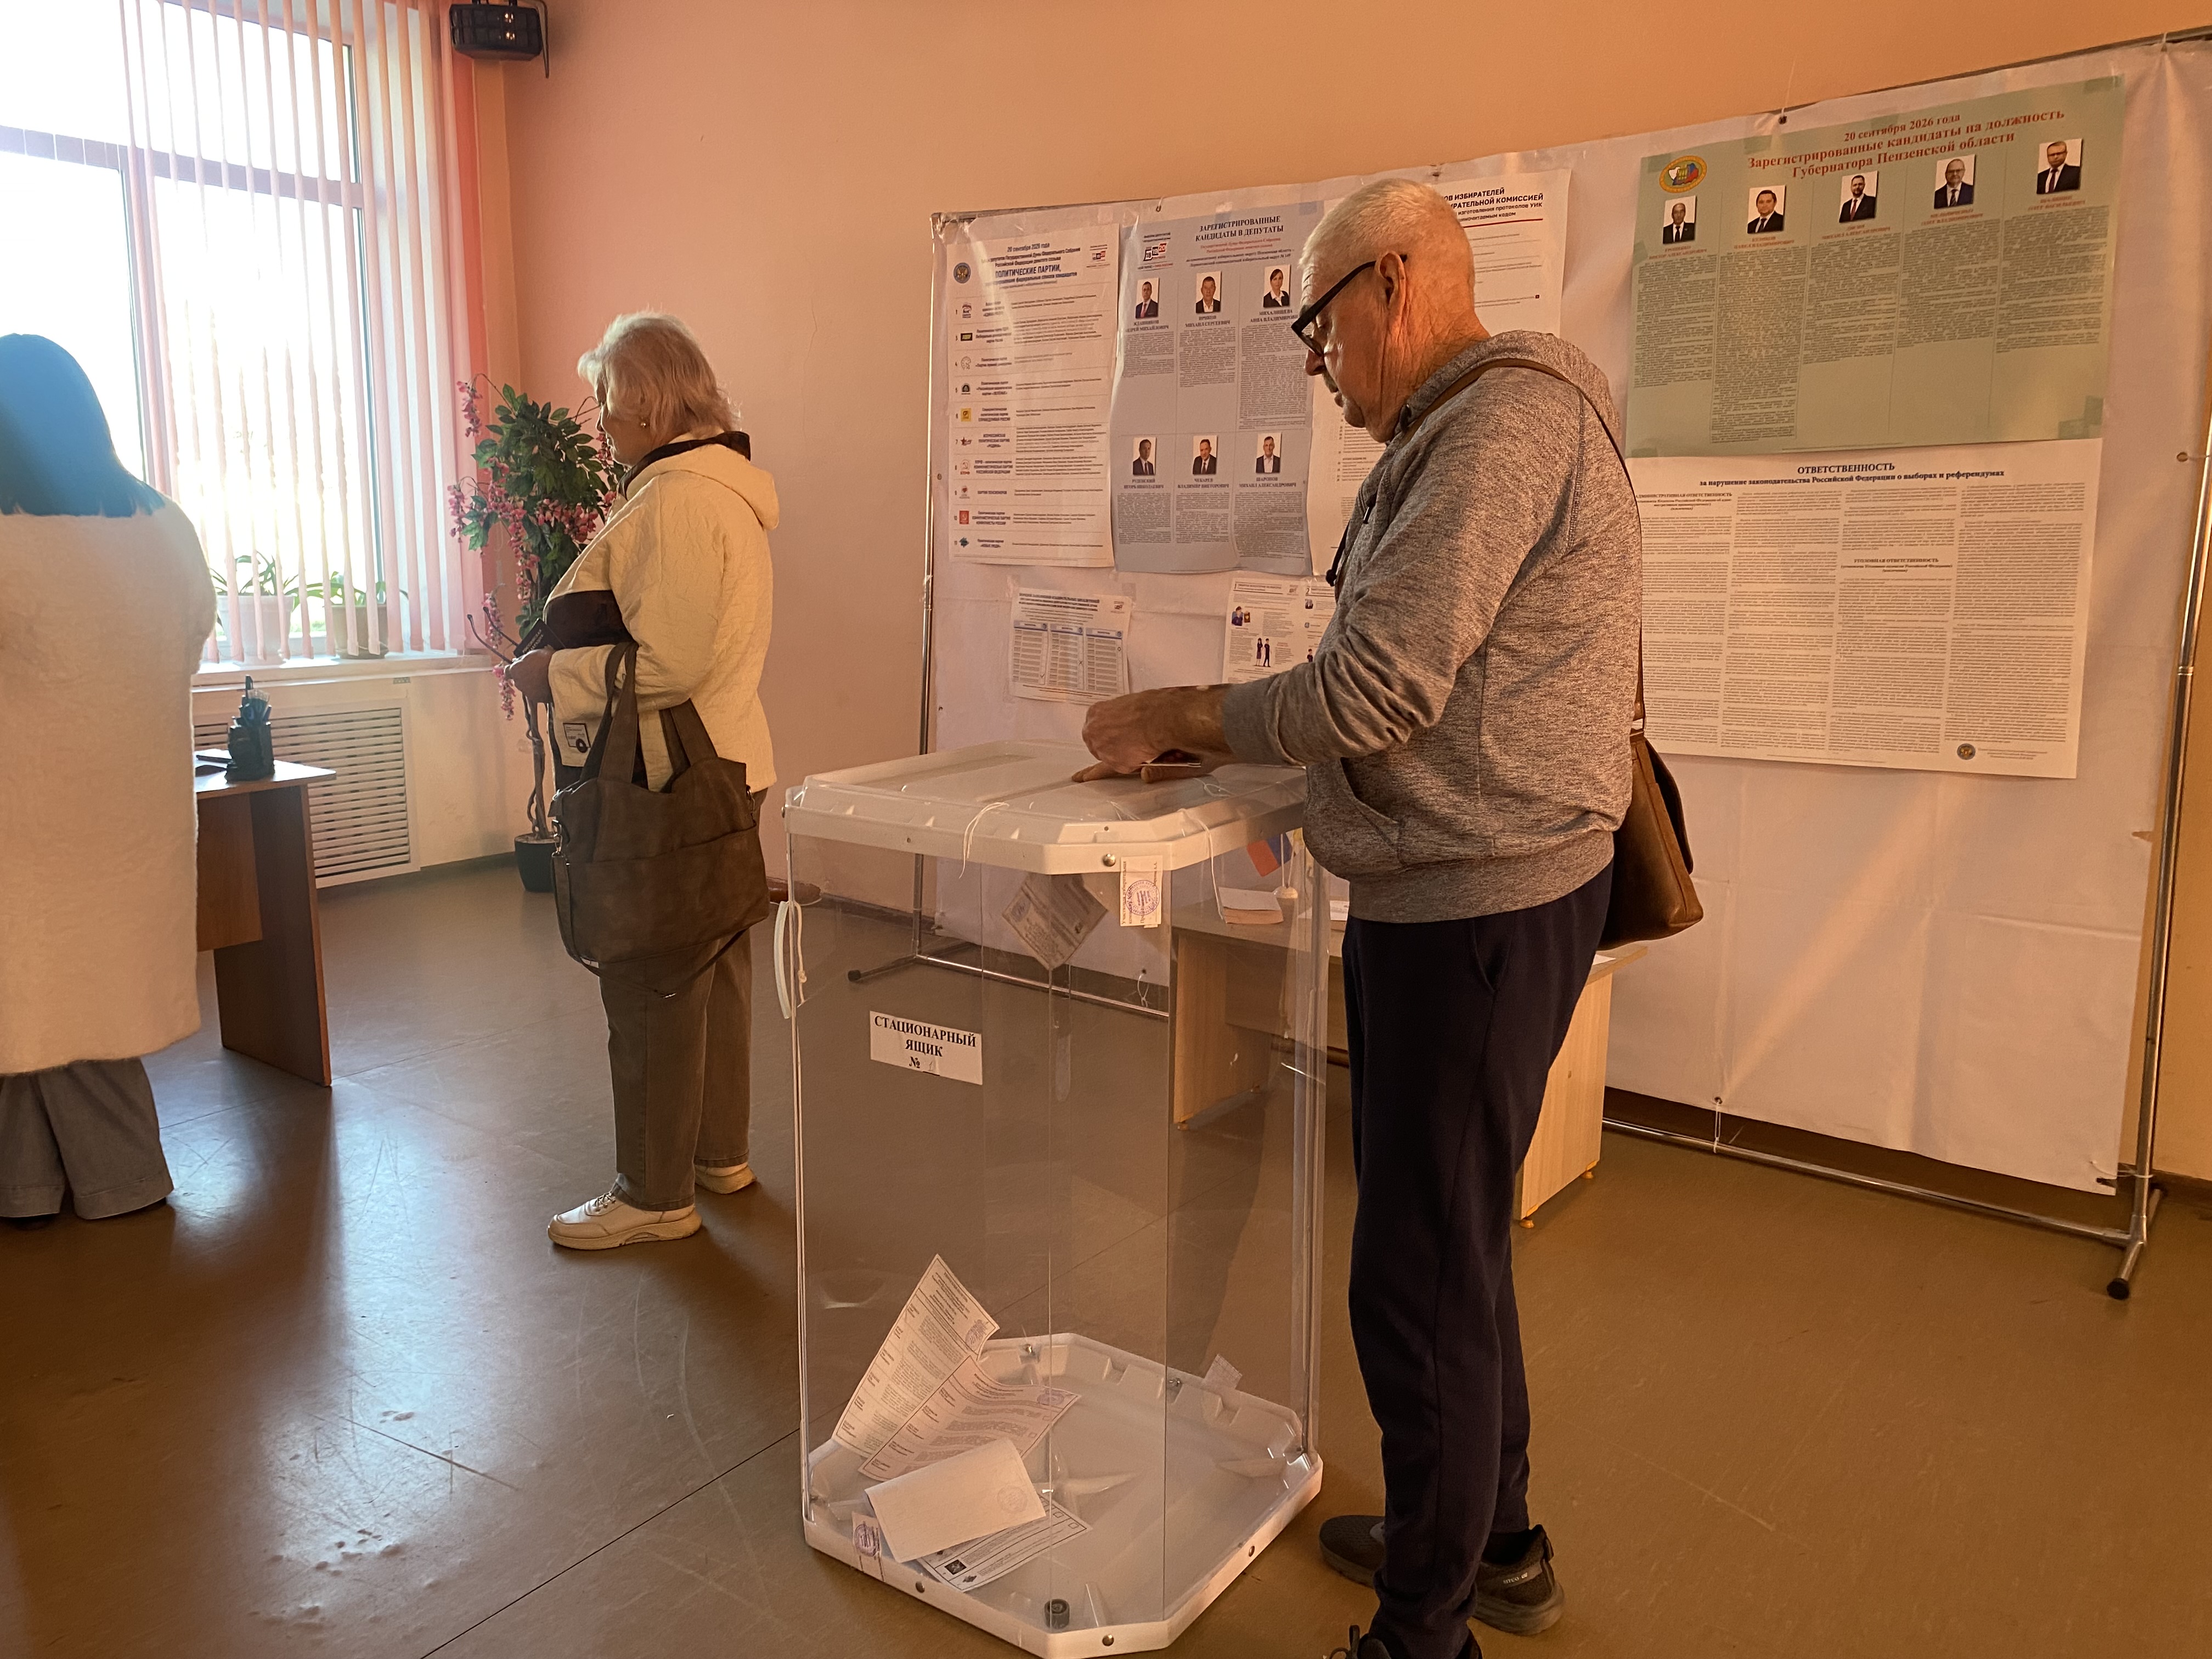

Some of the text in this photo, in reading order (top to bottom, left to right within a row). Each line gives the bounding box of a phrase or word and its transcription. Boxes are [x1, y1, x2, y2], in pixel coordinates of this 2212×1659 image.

[1844, 114, 1960, 142] 20 сентября 2026 года
[1748, 111, 2064, 170] Зарегистрированные кандидаты на должность
[1793, 132, 2015, 179] Губернатора Пензенской области
[1451, 193, 1543, 209] РАТЕЛЬНОЙ КОМИССИЕЙ
[1454, 187, 1504, 201] ИЗБИРАТЕЛЕЙ
[1496, 204, 1528, 212] протоколов
[1199, 215, 1281, 233] ЗАРЕГИСТРИРОВАННЫЕ
[1195, 230, 1237, 242] КАНДИДАТЫ
[1244, 225, 1284, 236] ДЕПУТАТЫ
[995, 267, 1036, 278] ПОЛИТИЧЕСКИЕ
[1797, 462, 1895, 474] ОТВЕТСТВЕННОСТЬ
[1812, 475, 1854, 483] Российской
[1904, 472, 1937, 481] выборах
[1946, 470, 2005, 479] референдумах
[874, 1015, 976, 1047] СТАЦИОНАРНЫЙ
[905, 1039, 943, 1057] ЯЩИК
[909, 1057, 920, 1068] №
